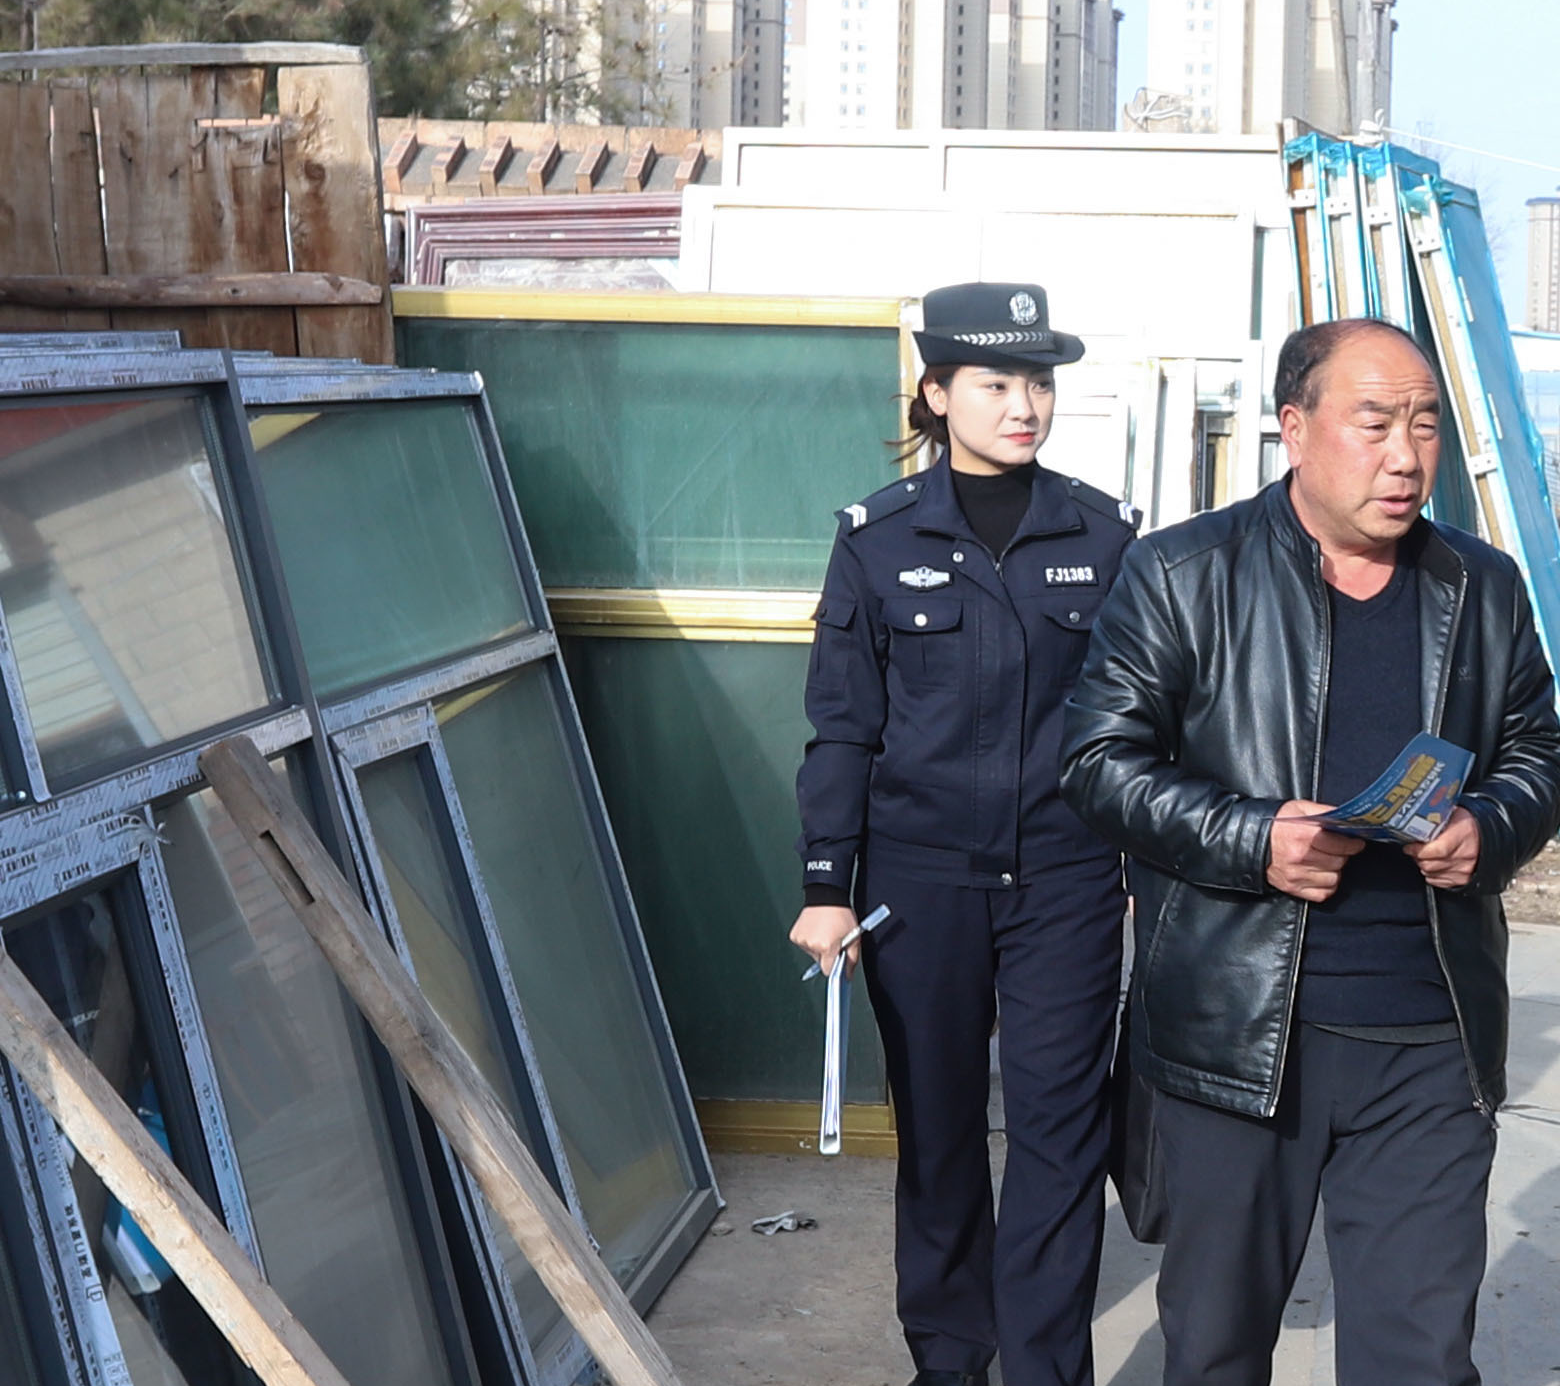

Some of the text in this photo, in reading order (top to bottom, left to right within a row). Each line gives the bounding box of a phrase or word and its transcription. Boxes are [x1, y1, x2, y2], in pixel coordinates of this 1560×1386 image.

[807, 860, 832, 871] POLICE
[59, 1203, 95, 1278] 高端门窗系统
